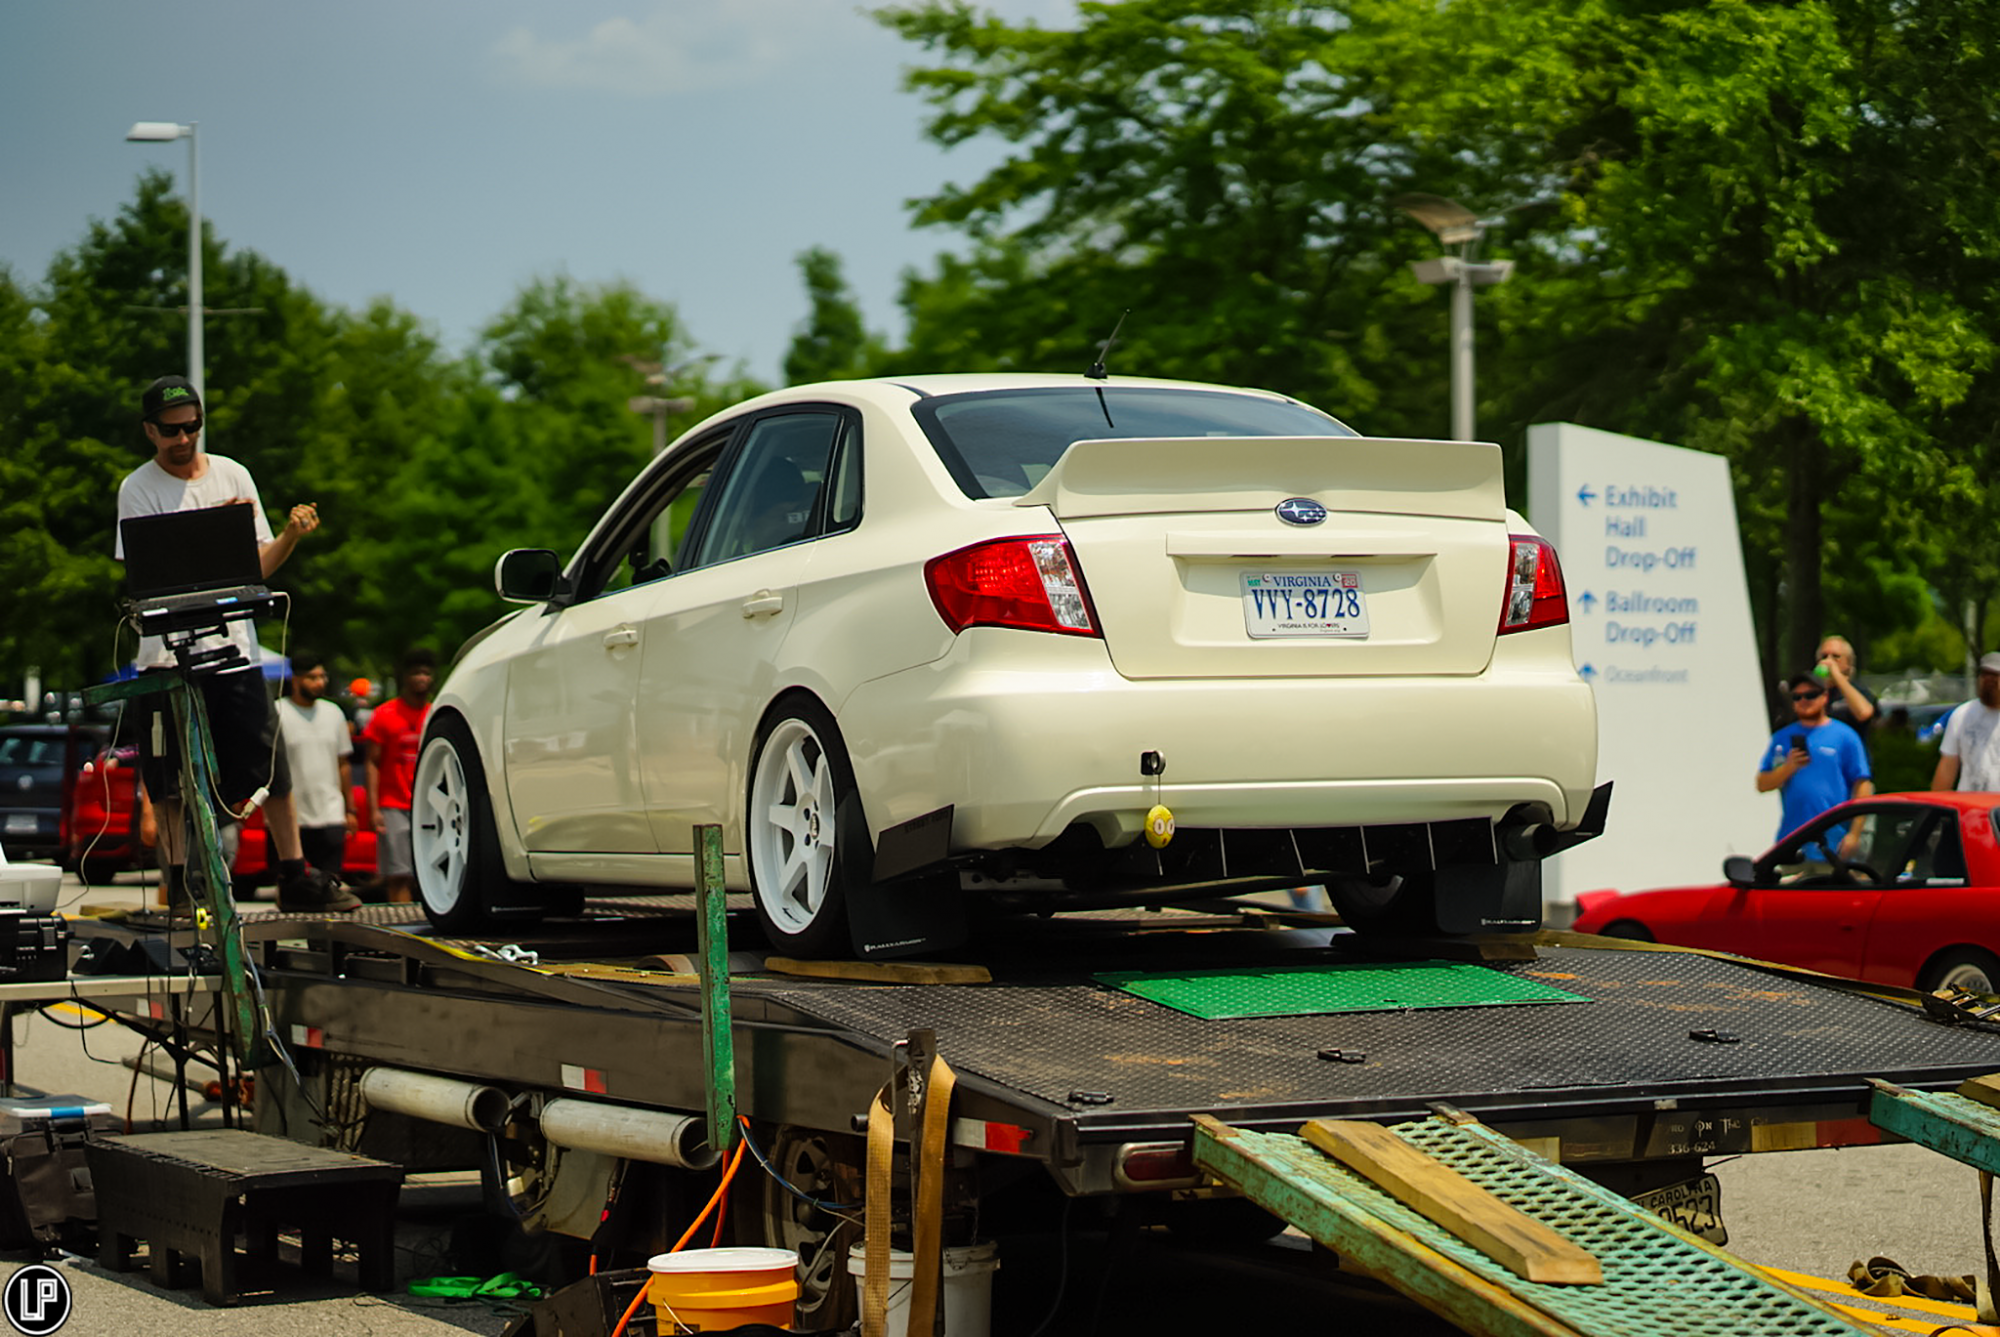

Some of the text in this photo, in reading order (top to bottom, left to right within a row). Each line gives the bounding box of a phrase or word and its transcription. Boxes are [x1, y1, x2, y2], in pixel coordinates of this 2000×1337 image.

[1604, 484, 1678, 508] Exhibit
[1604, 515, 1645, 537] Hall
[1604, 545, 1696, 571] Drop-Off
[1273, 576, 1332, 587] VIRGINIA
[1251, 588, 1361, 620] VVY-8728
[1604, 590, 1699, 613] Ballroom
[1604, 620, 1696, 647] Drop-Off
[1604, 664, 1689, 684] Oceanfront
